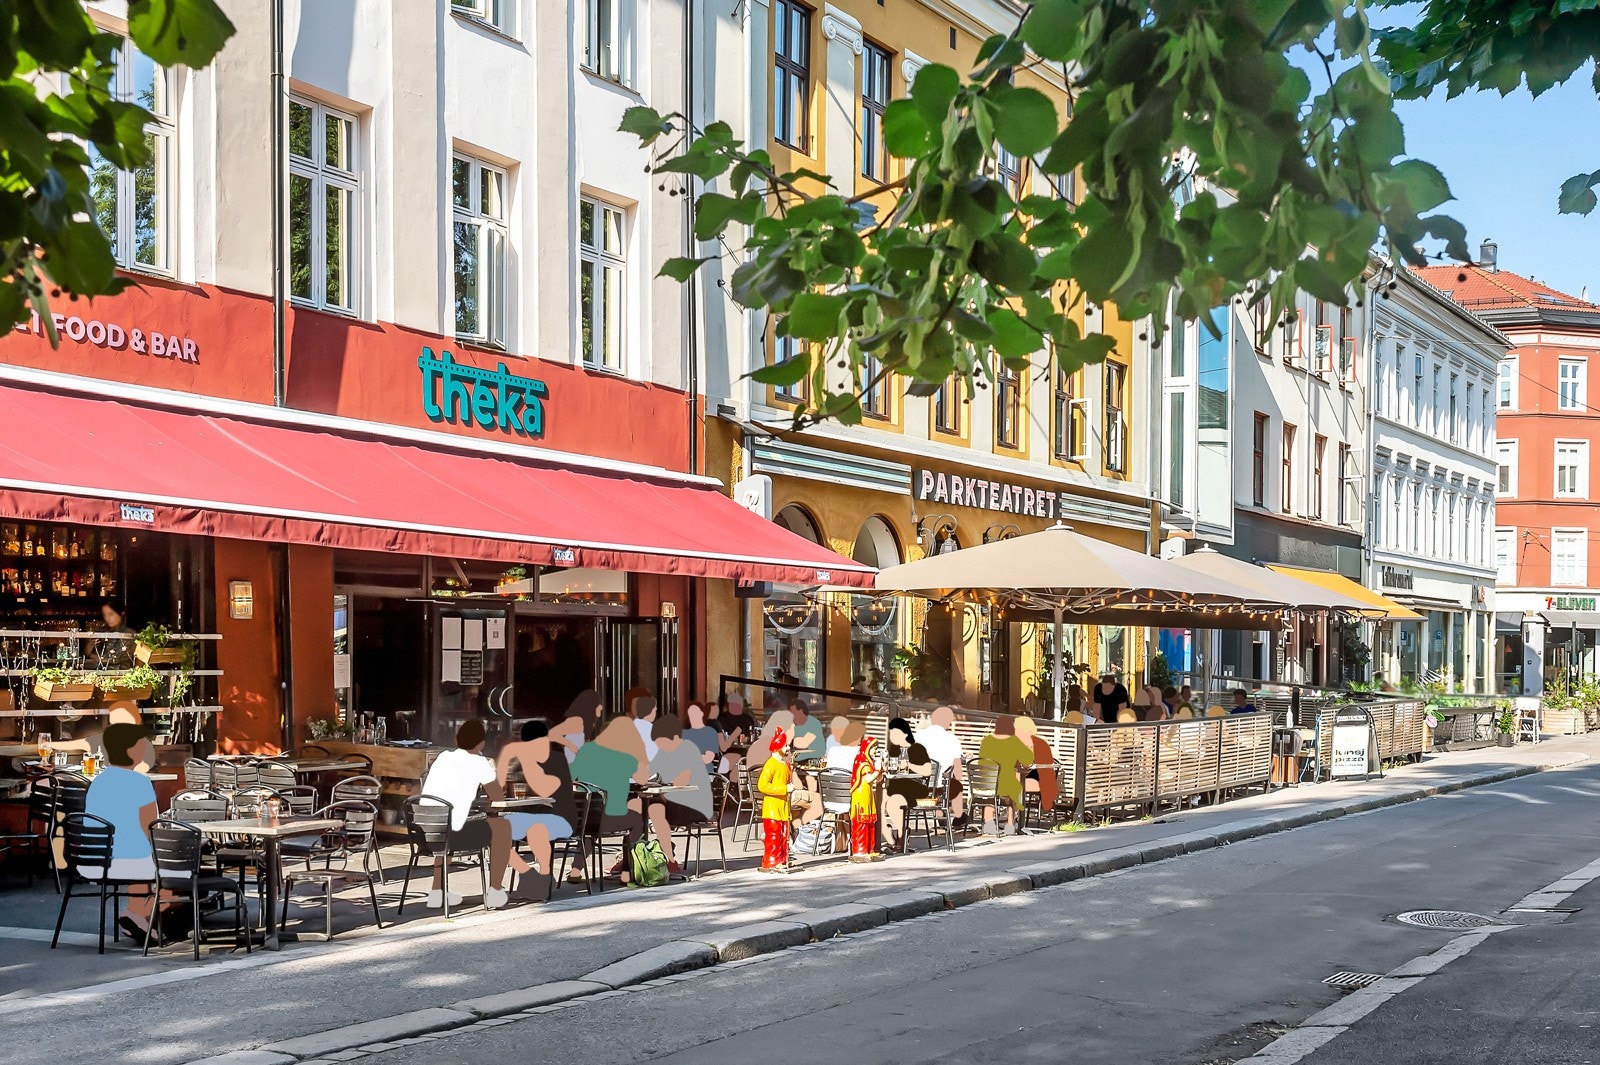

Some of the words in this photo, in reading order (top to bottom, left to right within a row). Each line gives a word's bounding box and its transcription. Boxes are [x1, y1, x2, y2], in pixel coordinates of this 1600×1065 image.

[51, 312, 125, 347] FOOD
[129, 328, 146, 353] &
[151, 331, 198, 362] BAR
[417, 346, 546, 434] theka
[120, 503, 155, 522] theka
[919, 469, 1057, 519] PARKTEATRET
